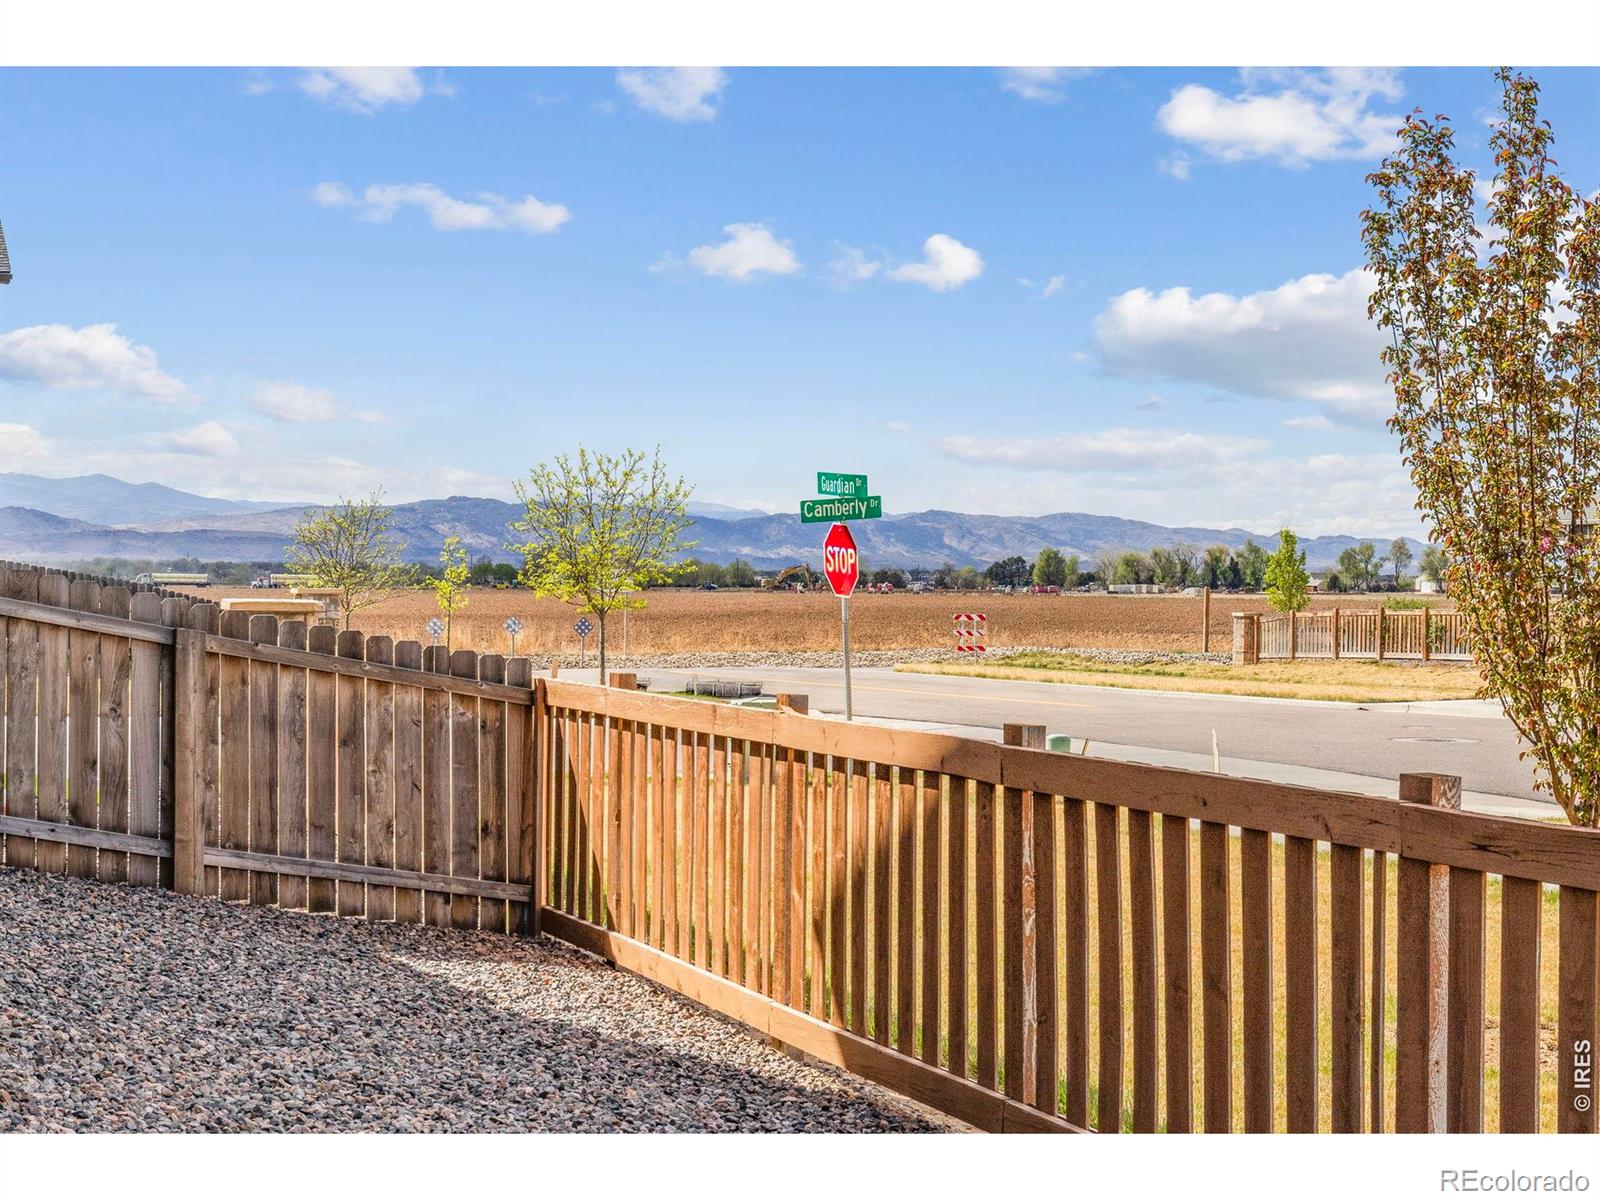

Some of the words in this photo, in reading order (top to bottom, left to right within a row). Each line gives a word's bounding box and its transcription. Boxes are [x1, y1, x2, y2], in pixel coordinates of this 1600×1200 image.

[821, 476, 855, 494] Guardian
[856, 478, 862, 486] Dr
[804, 499, 867, 518] Camberly
[870, 499, 879, 508] Dr
[826, 545, 856, 574] STOP
